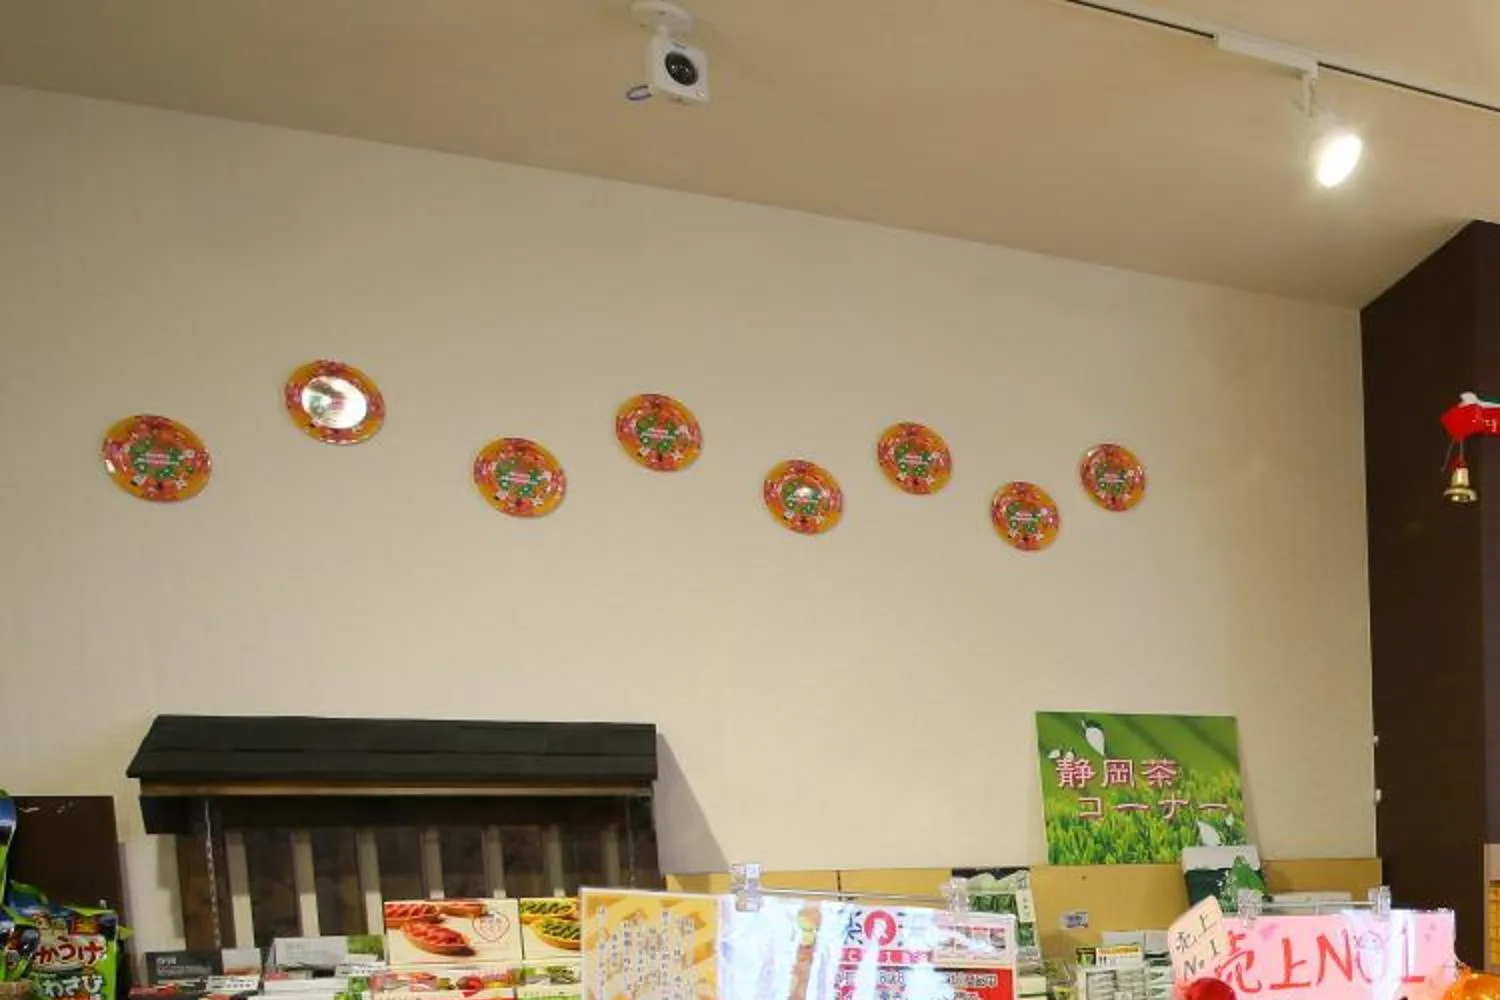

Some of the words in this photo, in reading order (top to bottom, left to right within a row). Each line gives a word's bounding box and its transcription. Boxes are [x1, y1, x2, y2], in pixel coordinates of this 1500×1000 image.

[1055, 757, 1180, 790] 静岡茶
[1078, 793, 1231, 821] コーナー
